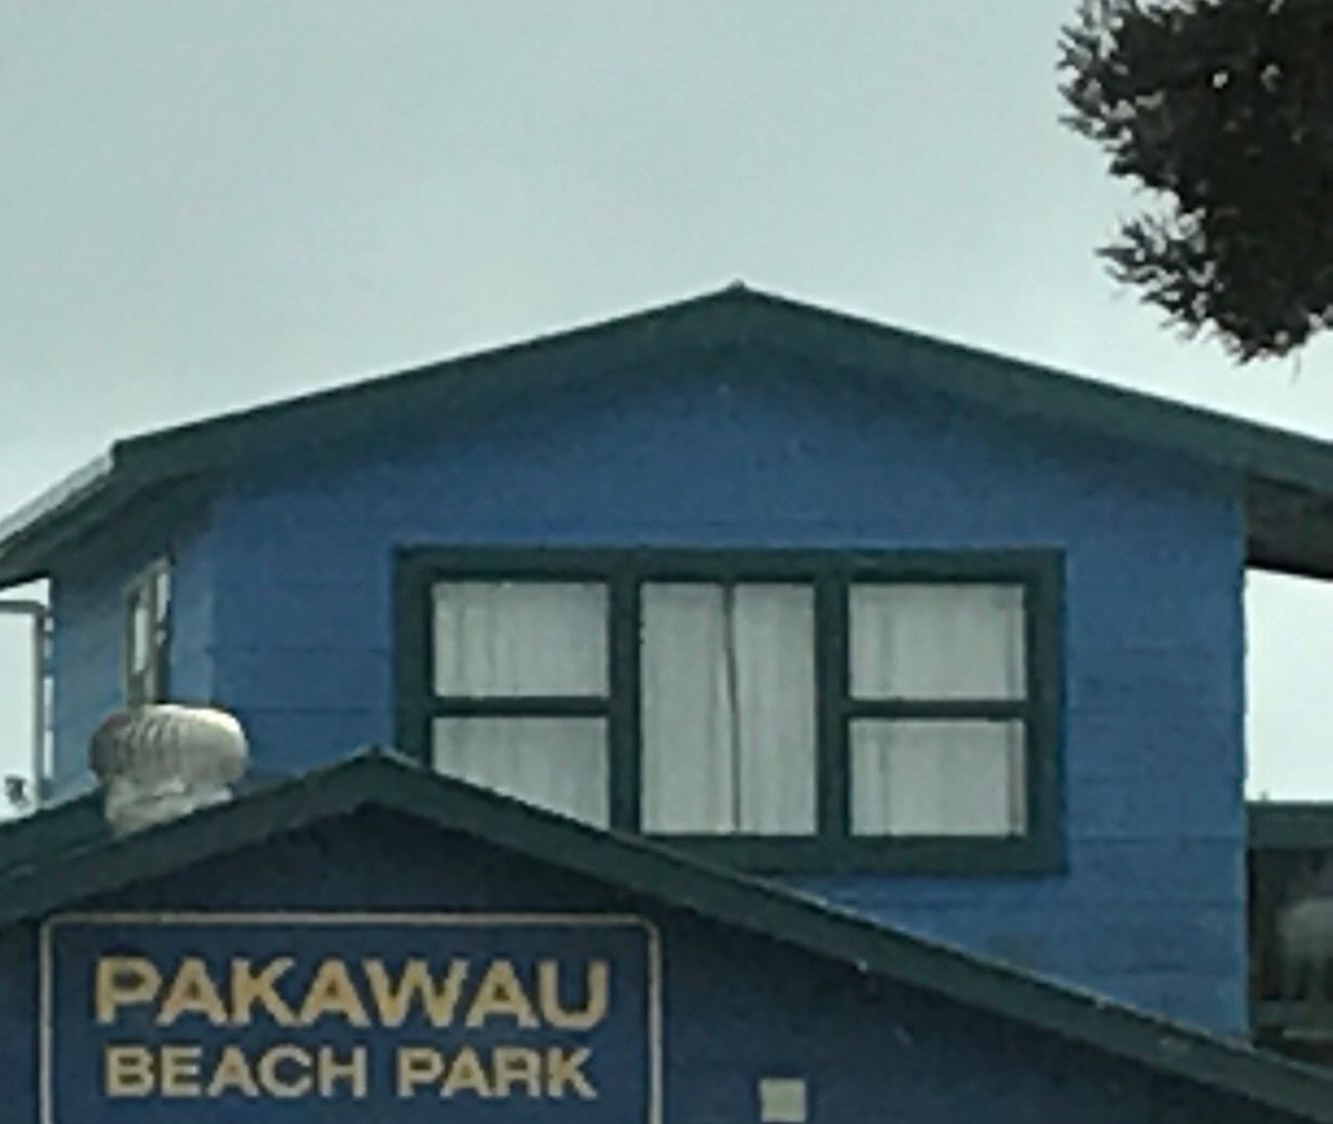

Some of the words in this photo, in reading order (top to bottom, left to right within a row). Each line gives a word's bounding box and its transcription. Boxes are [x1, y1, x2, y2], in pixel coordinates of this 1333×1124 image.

[93, 955, 611, 1031] PAKAWAU
[103, 1044, 367, 1098] BEACH
[396, 1045, 597, 1099] PARK
